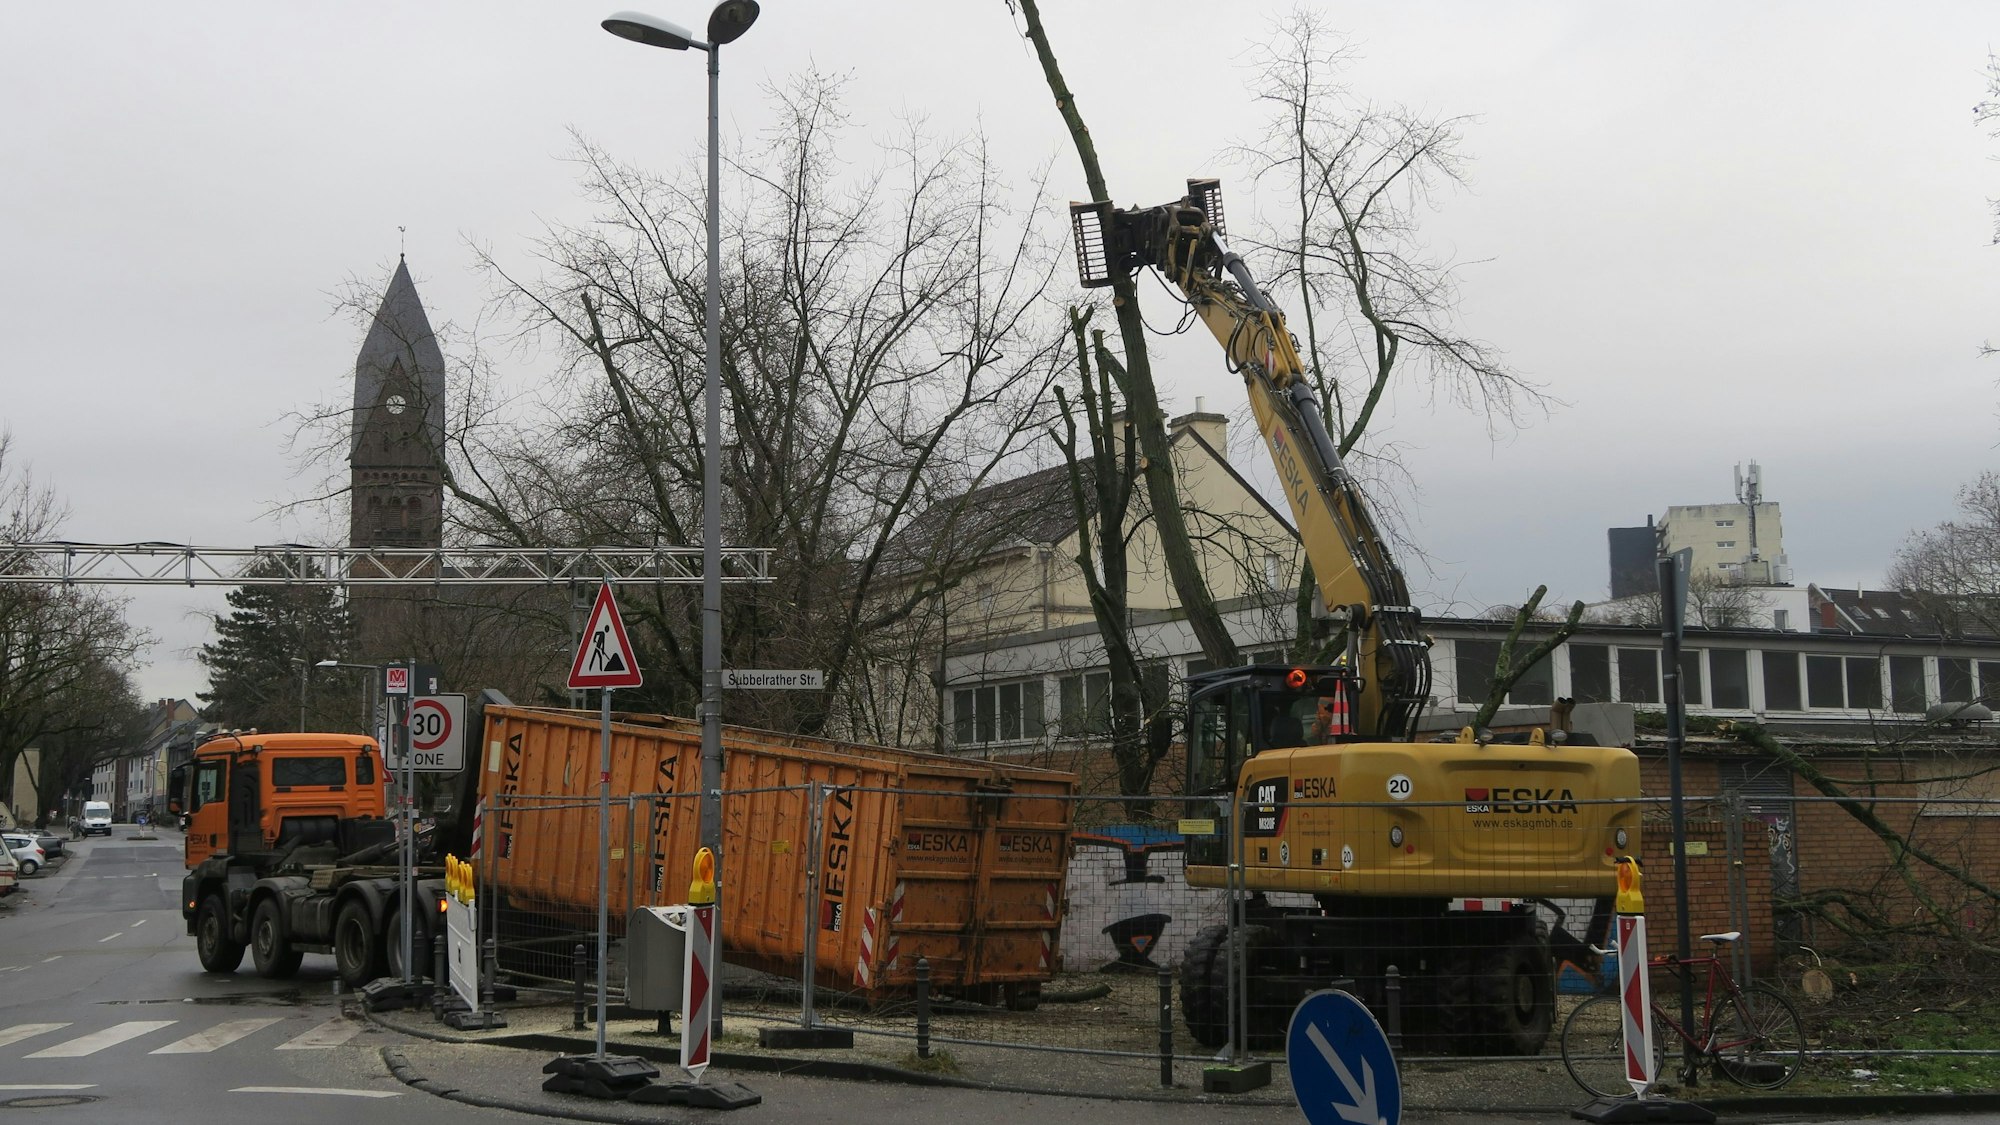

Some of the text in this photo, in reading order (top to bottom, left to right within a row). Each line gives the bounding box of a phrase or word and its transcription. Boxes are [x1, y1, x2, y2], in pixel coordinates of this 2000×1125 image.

[1279, 441, 1309, 516] ESKA
[728, 673, 818, 686] Subbelrather Str.
[413, 713, 441, 735] 30
[406, 753, 444, 766] ONE
[1304, 777, 1336, 799] ESKA
[1389, 779, 1410, 793] 20
[1258, 785, 1276, 812] CAT
[1492, 788, 1578, 814] ESKA
[1466, 805, 1490, 813] ESKA
[1473, 819, 1574, 831] www.eskagmbh.de
[825, 783, 855, 897] ESKA
[922, 833, 968, 852] ESKA
[1012, 835, 1053, 853] ESKA
[1343, 850, 1352, 863] 20
[833, 903, 843, 932] ESKA
